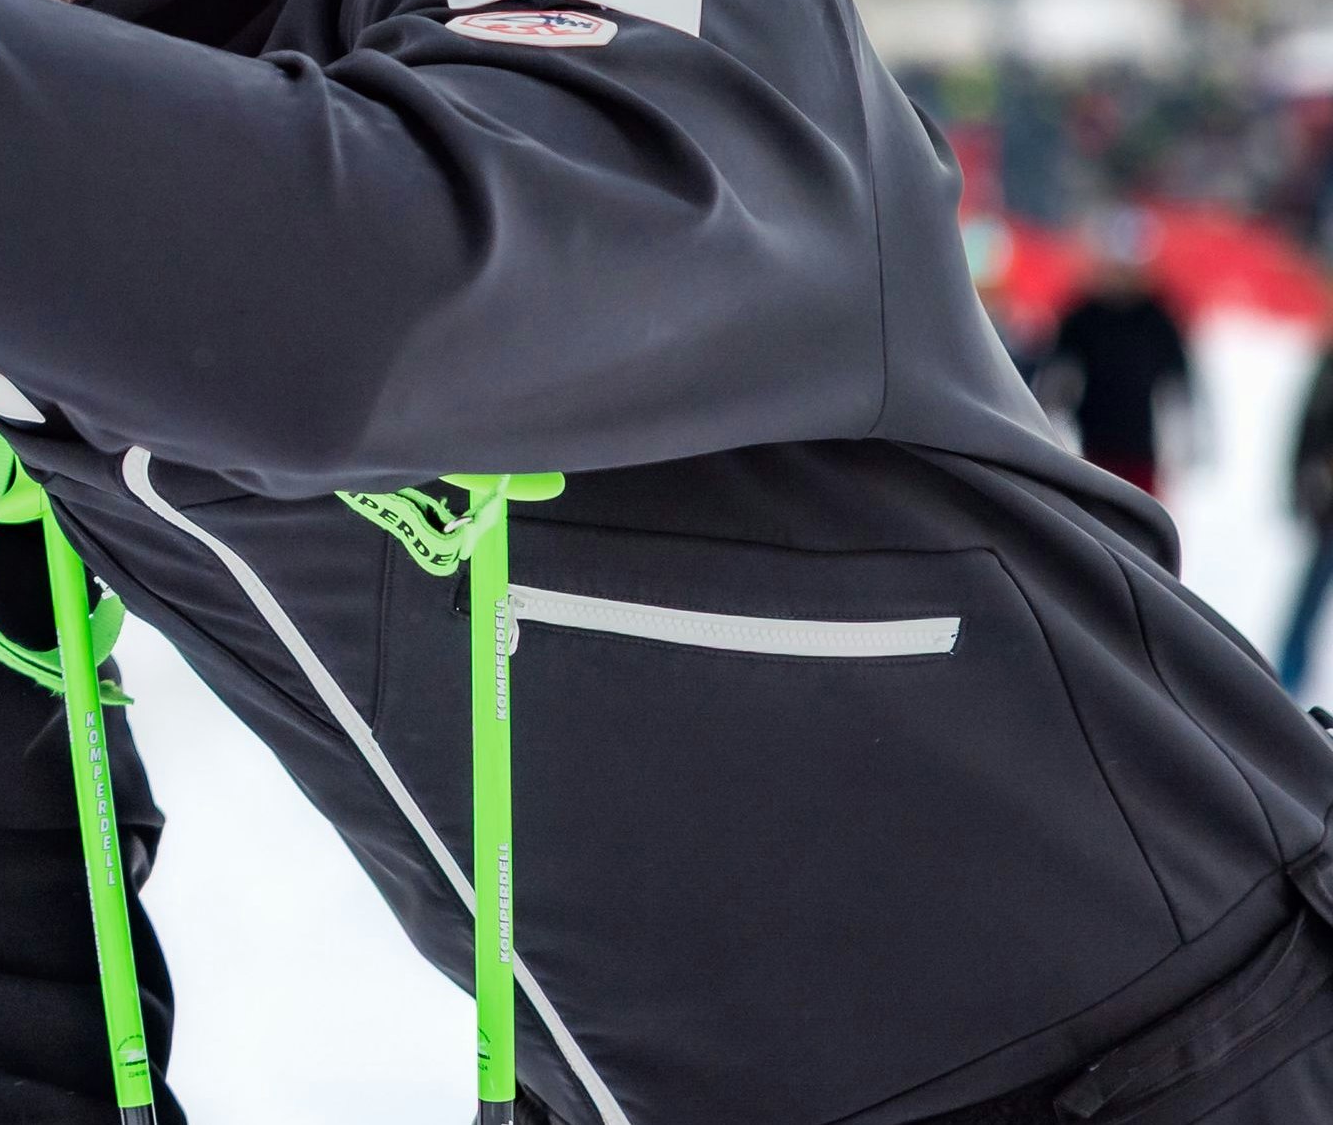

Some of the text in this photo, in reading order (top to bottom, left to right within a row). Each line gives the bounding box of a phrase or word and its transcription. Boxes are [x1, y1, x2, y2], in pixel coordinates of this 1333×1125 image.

[494, 599, 508, 722] KOMPERDELL
[85, 711, 116, 886] KOMPERDELL
[497, 842, 510, 965] KOMPERDELL
